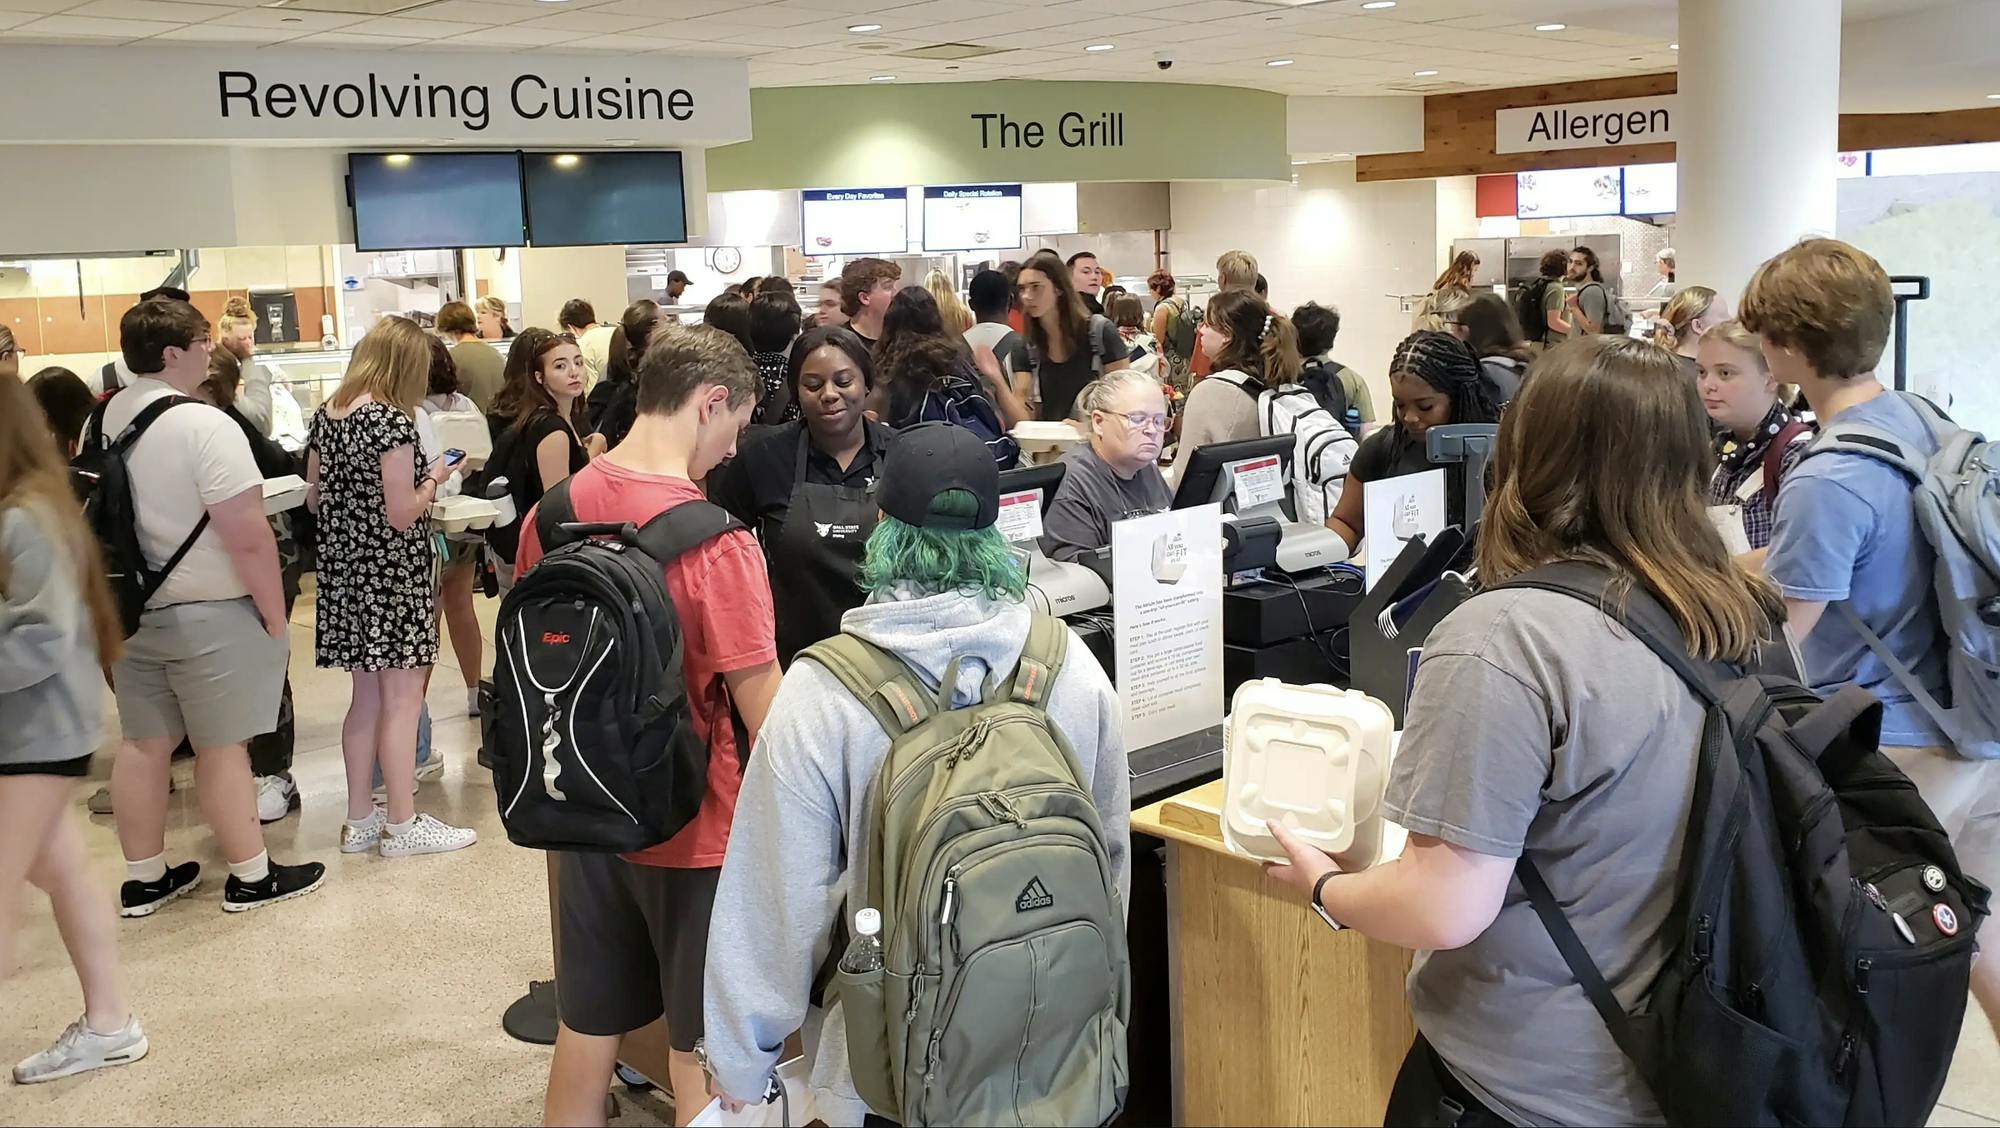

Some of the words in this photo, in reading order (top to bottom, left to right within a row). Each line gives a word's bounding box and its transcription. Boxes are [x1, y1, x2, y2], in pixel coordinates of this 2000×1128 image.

[219, 71, 489, 130] Revolving
[511, 75, 694, 121] Cuisine
[971, 114, 1045, 148] The
[1059, 112, 1123, 147] Grill
[1527, 105, 1669, 145] Allergen
[826, 192, 844, 200] Every
[845, 192, 857, 200] Day
[943, 190, 958, 199] Daily
[959, 190, 979, 198] Special
[1055, 595, 1076, 605] micros
[543, 631, 570, 645] Epic
[1019, 896, 1051, 910] adidas
